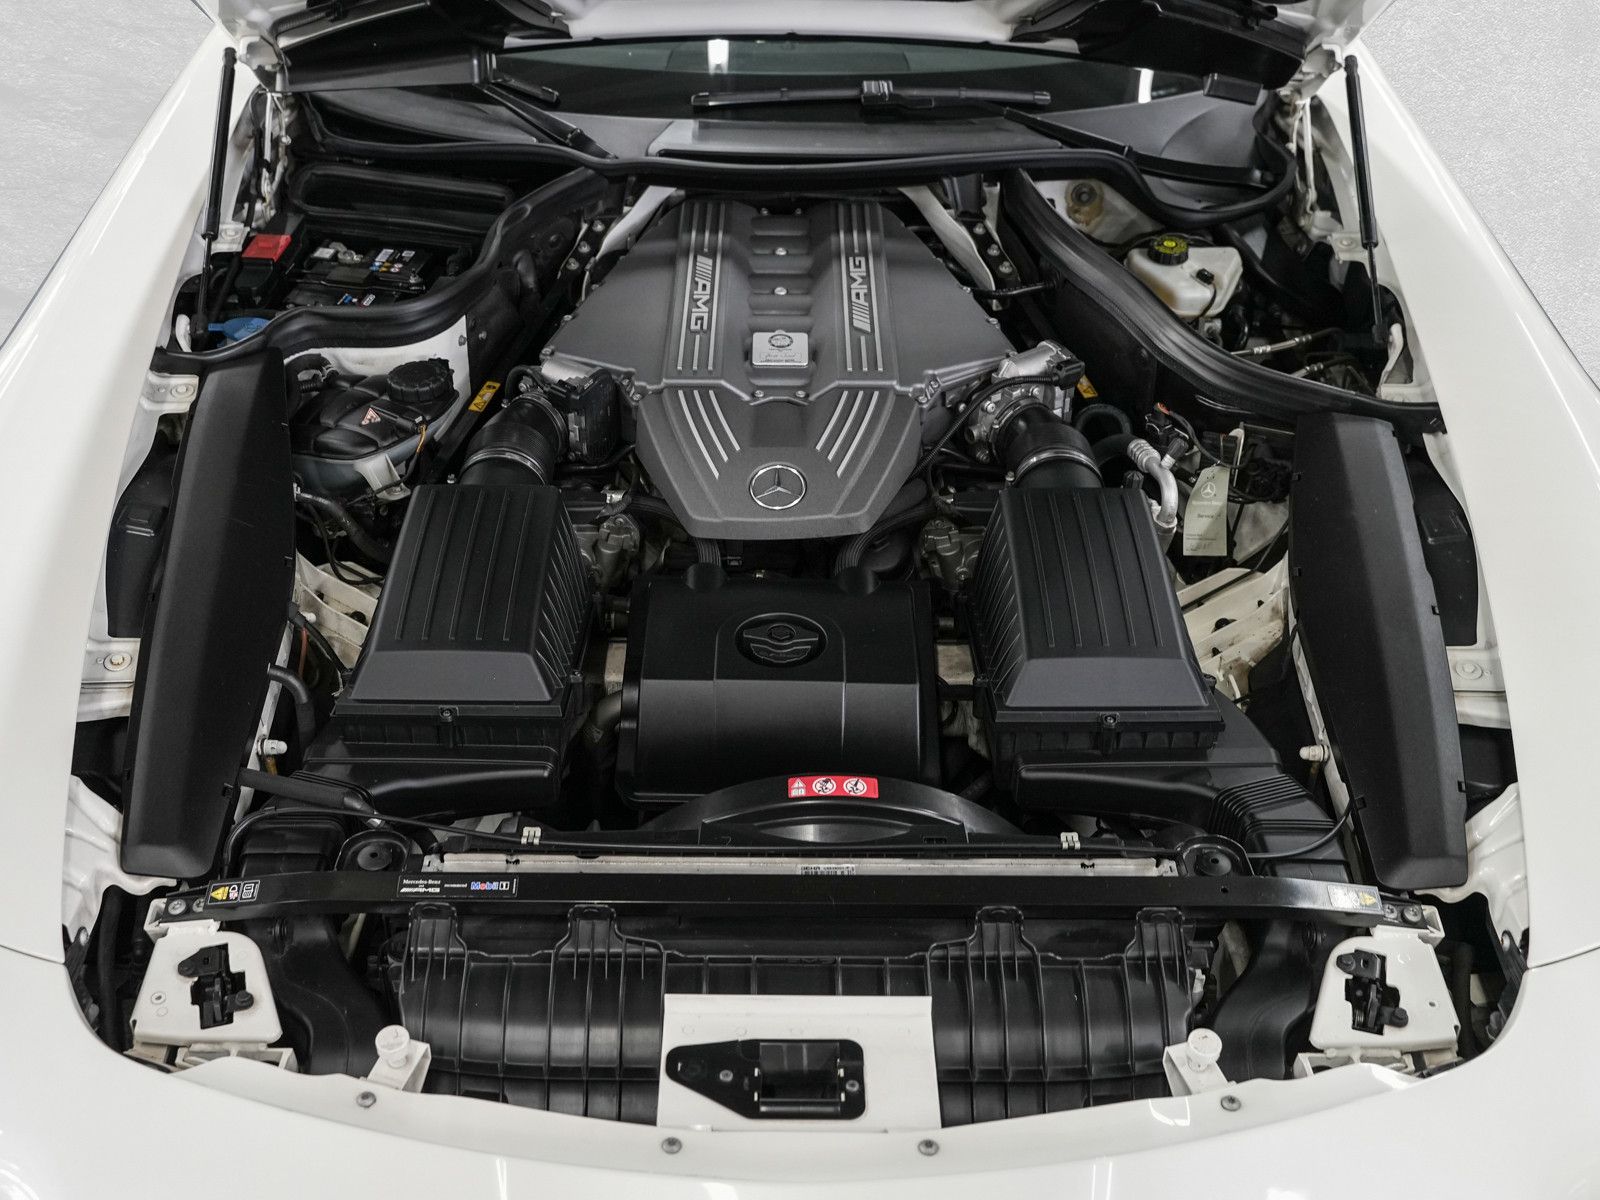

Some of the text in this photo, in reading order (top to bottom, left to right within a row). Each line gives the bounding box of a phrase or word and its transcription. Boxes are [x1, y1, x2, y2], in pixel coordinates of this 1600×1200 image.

[690, 276, 711, 331] AMG
[849, 256, 868, 306] AMG
[470, 881, 499, 891] Mobil
